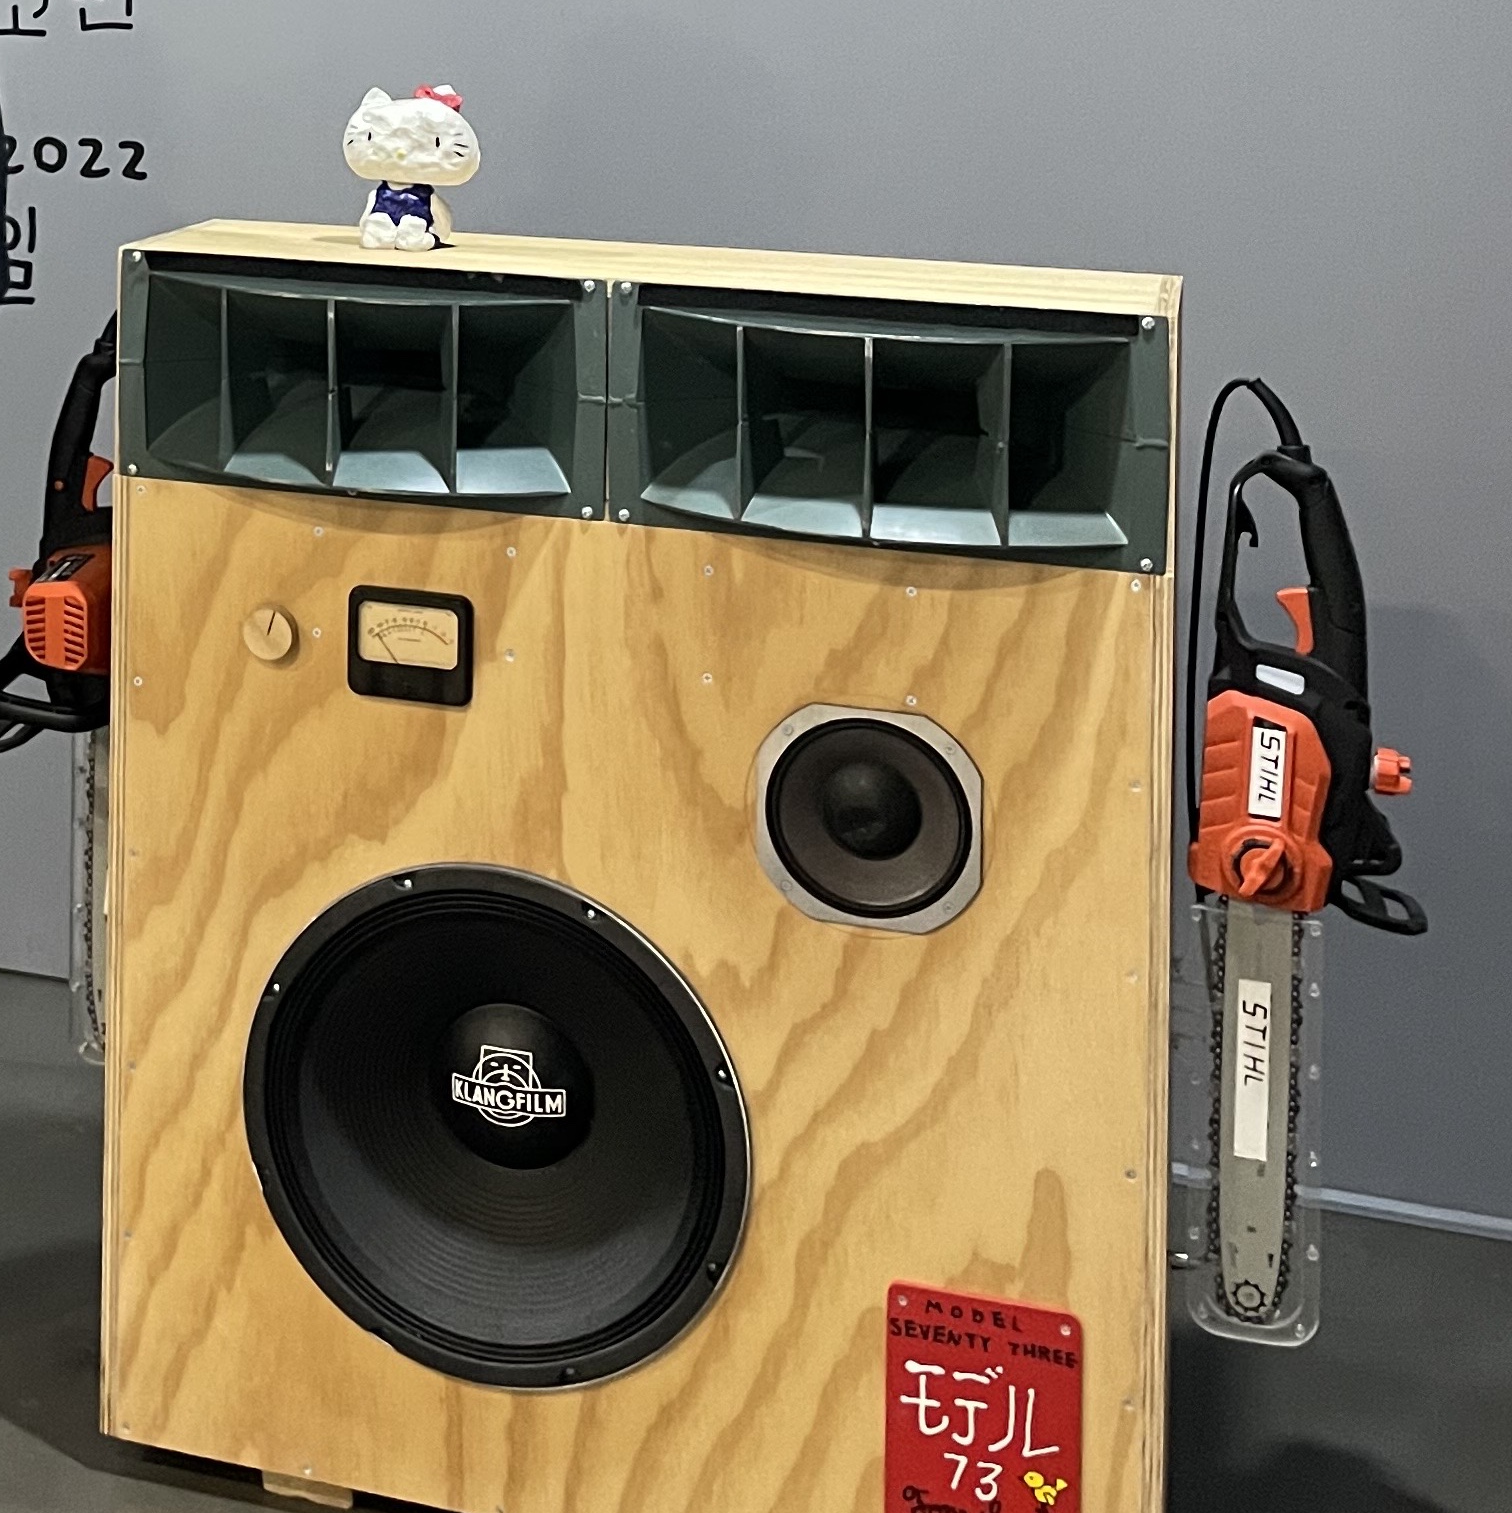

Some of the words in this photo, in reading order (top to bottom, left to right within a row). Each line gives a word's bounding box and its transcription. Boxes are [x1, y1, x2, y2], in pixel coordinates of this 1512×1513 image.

[1257, 731, 1281, 802] STIHL
[1242, 999, 1268, 1087] STIHL
[454, 1078, 562, 1114] KLANGFILM
[924, 1299, 1024, 1333] MODEL
[889, 1317, 991, 1353] SEVENTY
[1007, 1340, 1079, 1369] THREE
[943, 1452, 1003, 1502] 73
